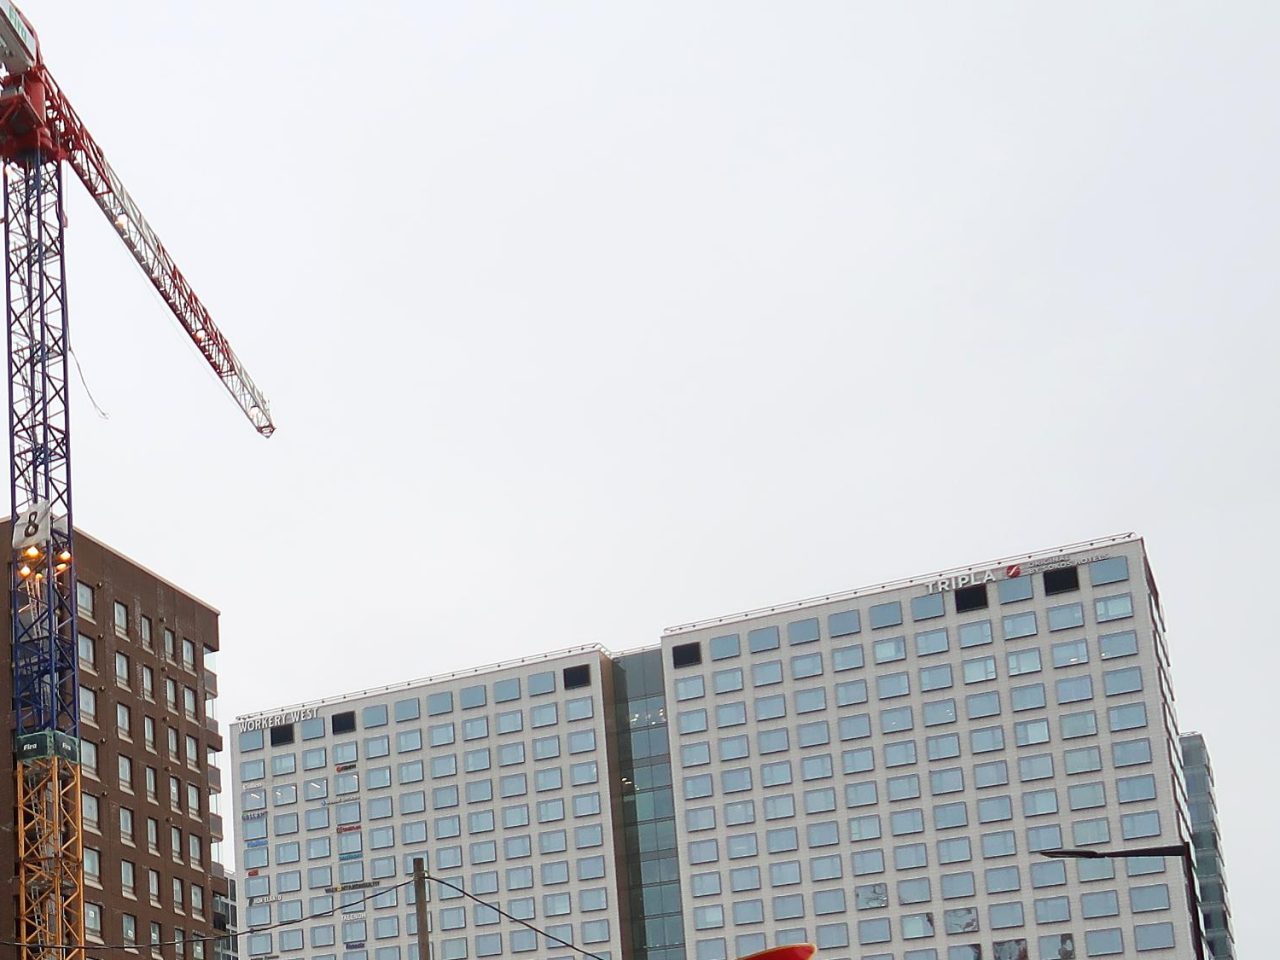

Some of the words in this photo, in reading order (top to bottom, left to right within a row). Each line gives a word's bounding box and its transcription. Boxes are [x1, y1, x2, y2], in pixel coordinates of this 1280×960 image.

[23, 511, 39, 538] 8
[1027, 554, 1071, 568] ORIGINAL
[925, 569, 996, 594] TRIPLA
[238, 713, 287, 733] WORKERY
[290, 707, 319, 723] WEST
[23, 743, 38, 751] Fira
